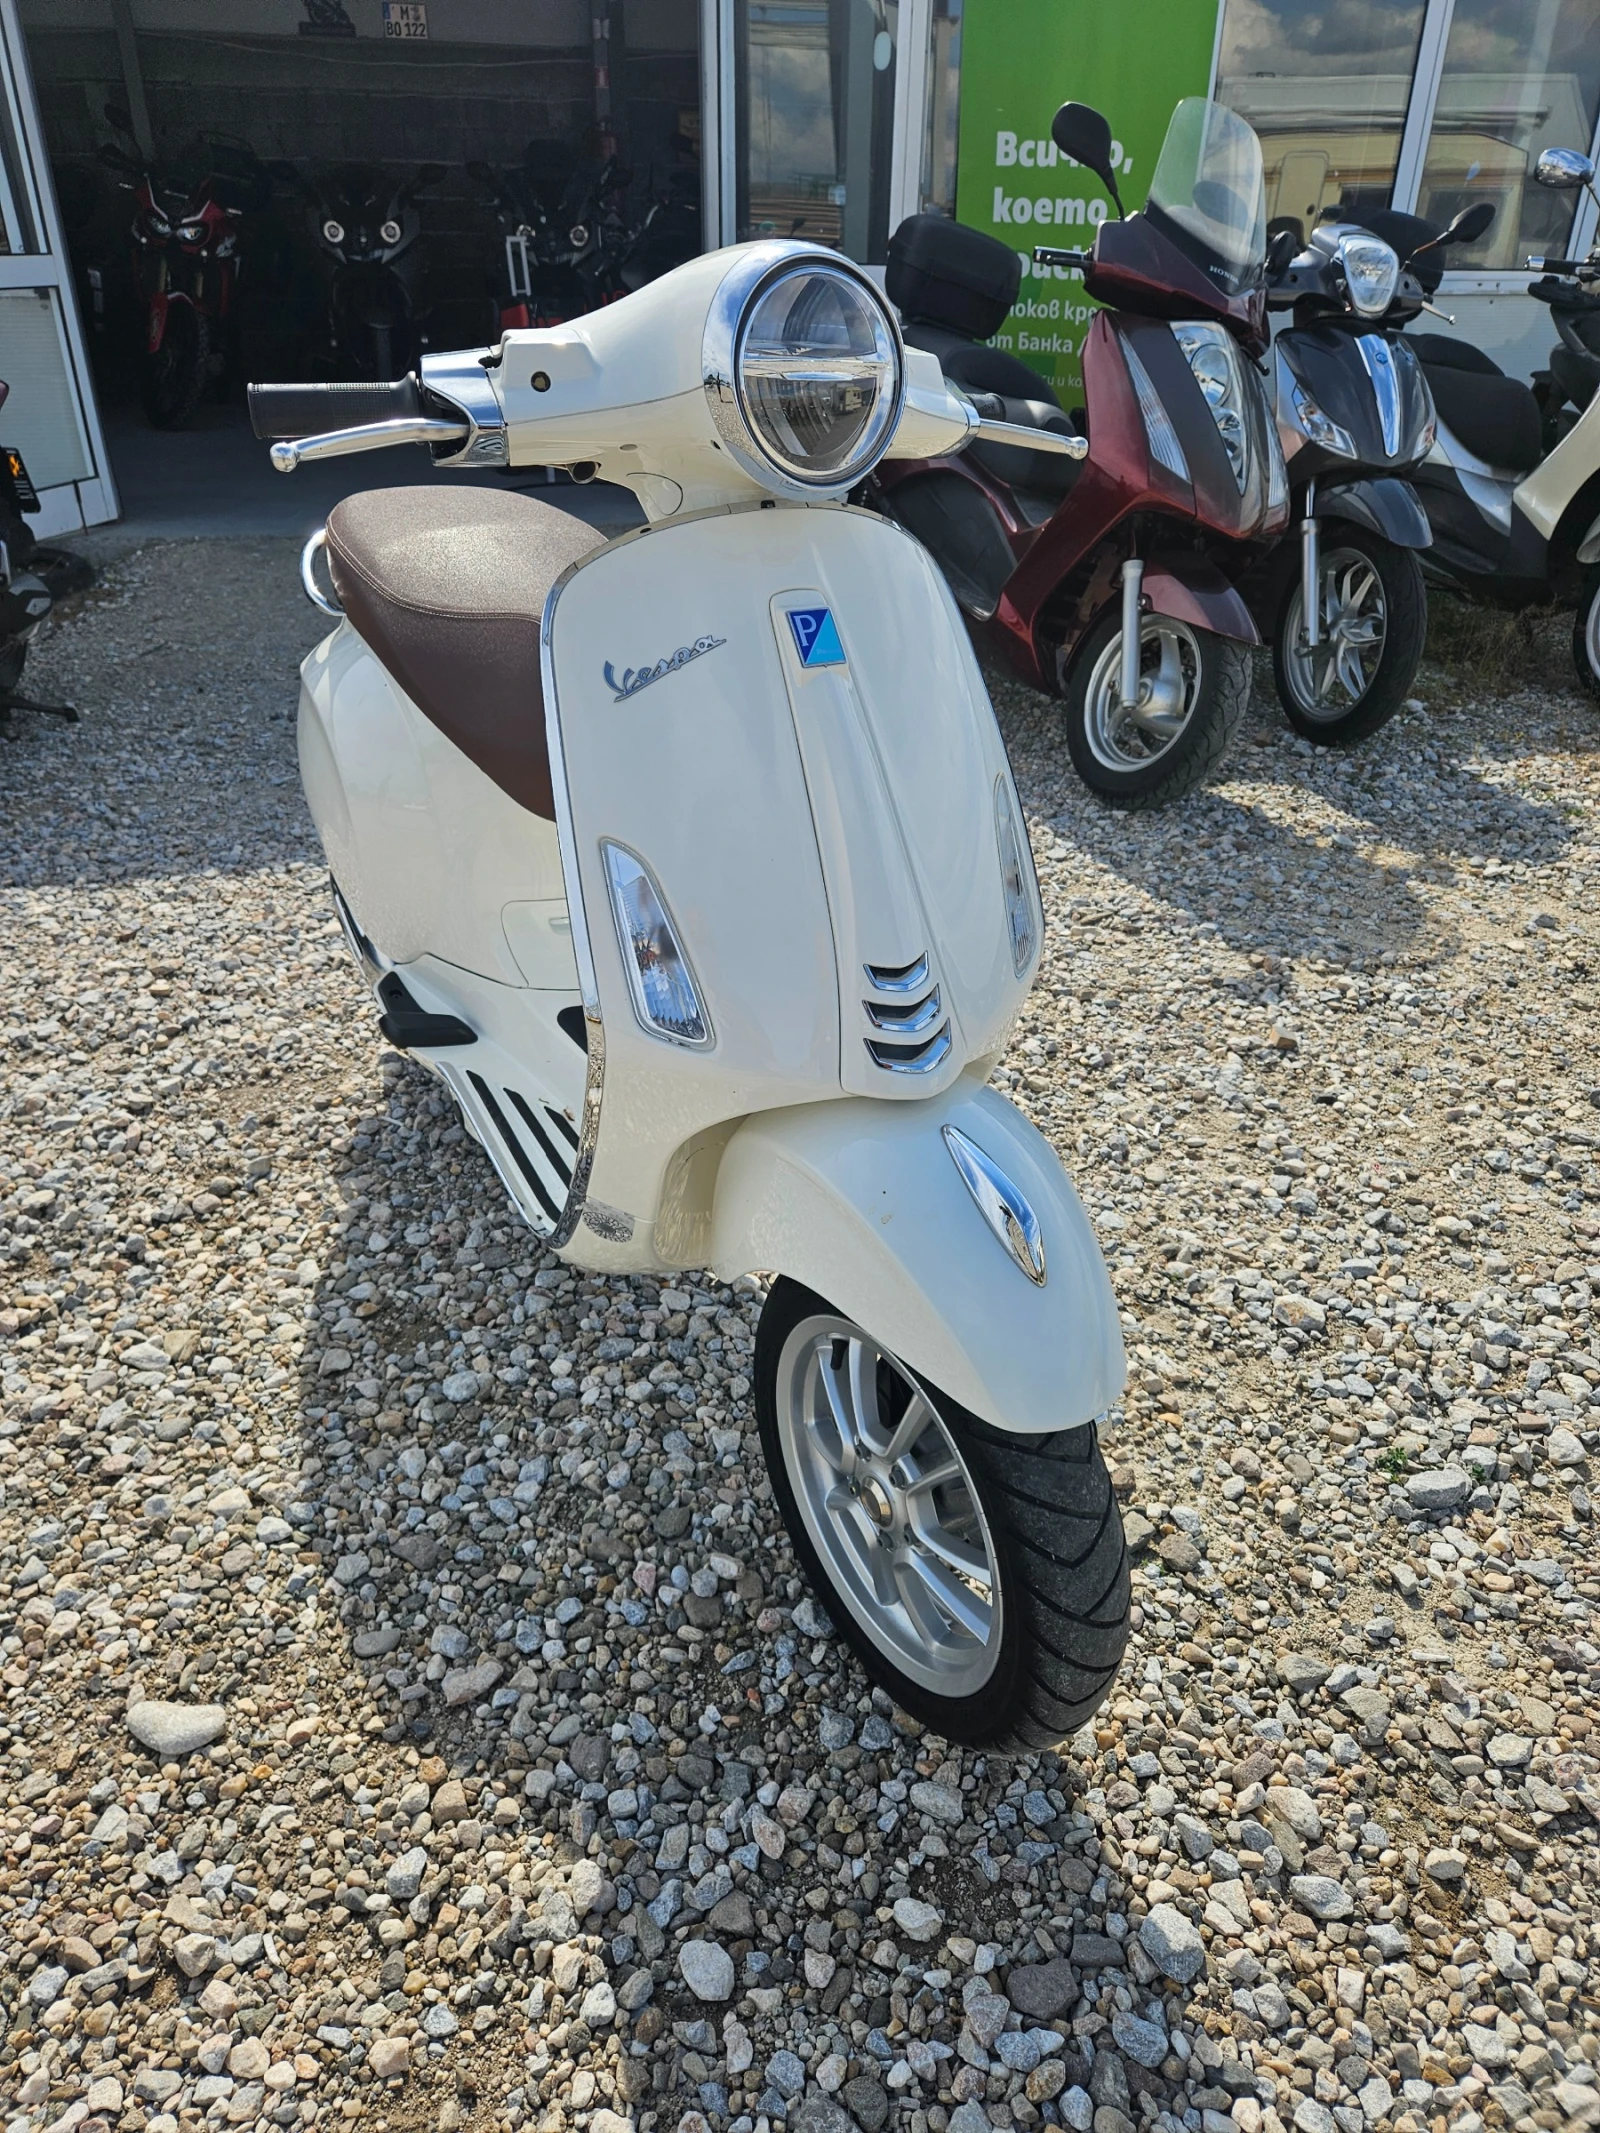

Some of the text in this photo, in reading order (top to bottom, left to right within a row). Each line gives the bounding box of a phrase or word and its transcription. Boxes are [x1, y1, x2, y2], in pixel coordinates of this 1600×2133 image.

[400, 6, 410, 21] M
[405, 23, 426, 37] 122
[993, 187, 1108, 225] което
[1010, 299, 1060, 319] оков
[1018, 331, 1073, 354] Банка
[604, 634, 727, 704] Vespa
